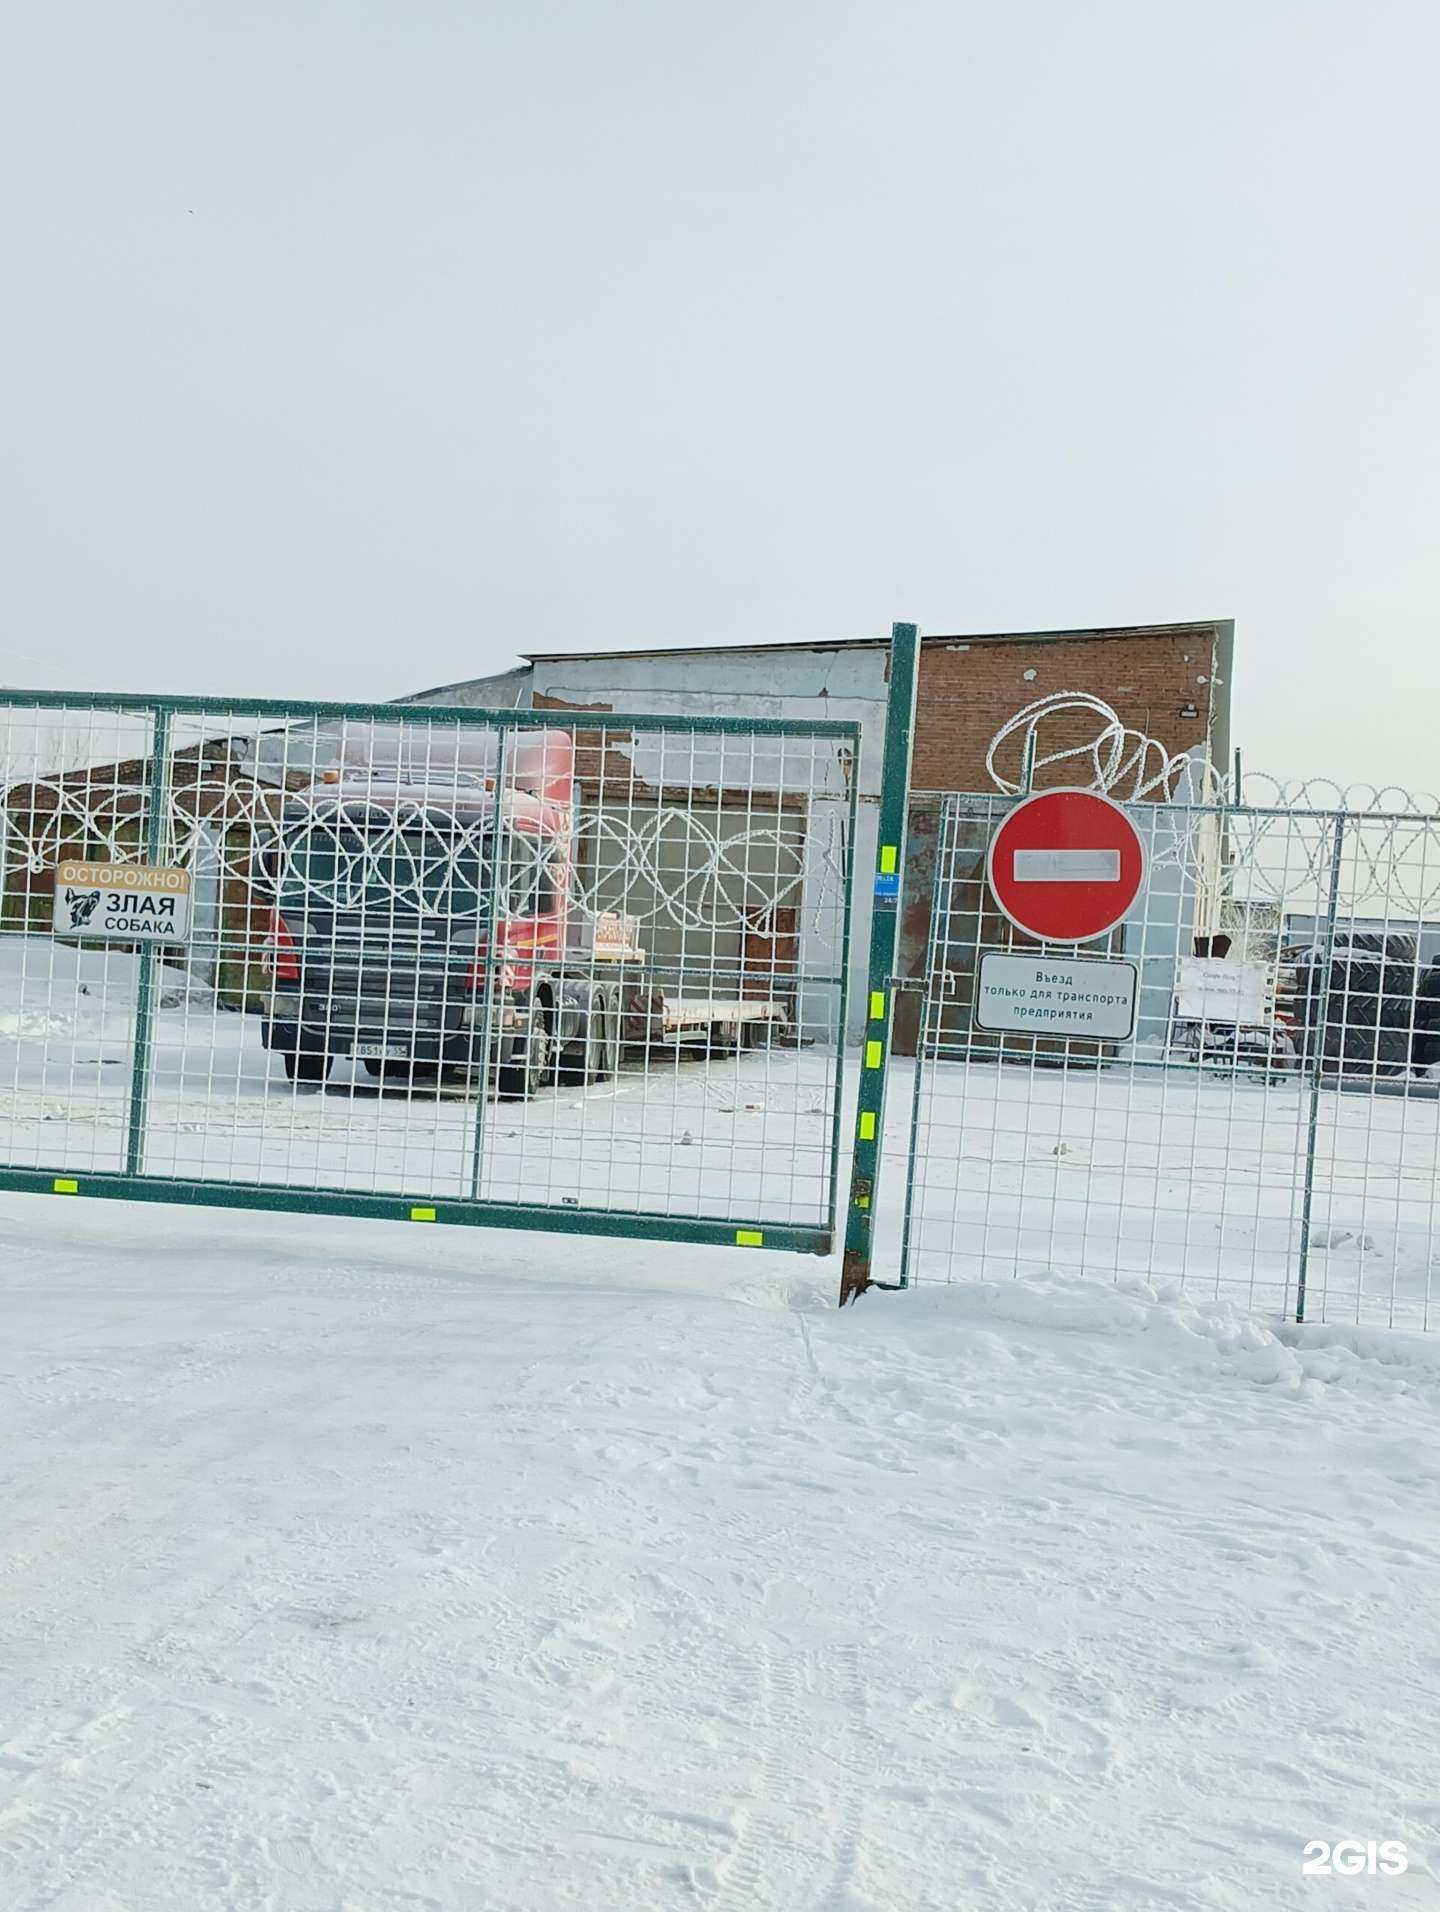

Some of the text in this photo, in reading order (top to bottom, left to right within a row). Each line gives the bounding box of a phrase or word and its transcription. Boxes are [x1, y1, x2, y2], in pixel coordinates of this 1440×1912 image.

[63, 866, 185, 888] ОСТОРОЖНО!
[106, 893, 175, 916] ЗЛАЯ
[104, 917, 175, 934] СОБАКА
[1035, 971, 1073, 986] Въезд
[984, 985, 1128, 1006] только для транспорта
[1013, 1006, 1093, 1020] предприятия
